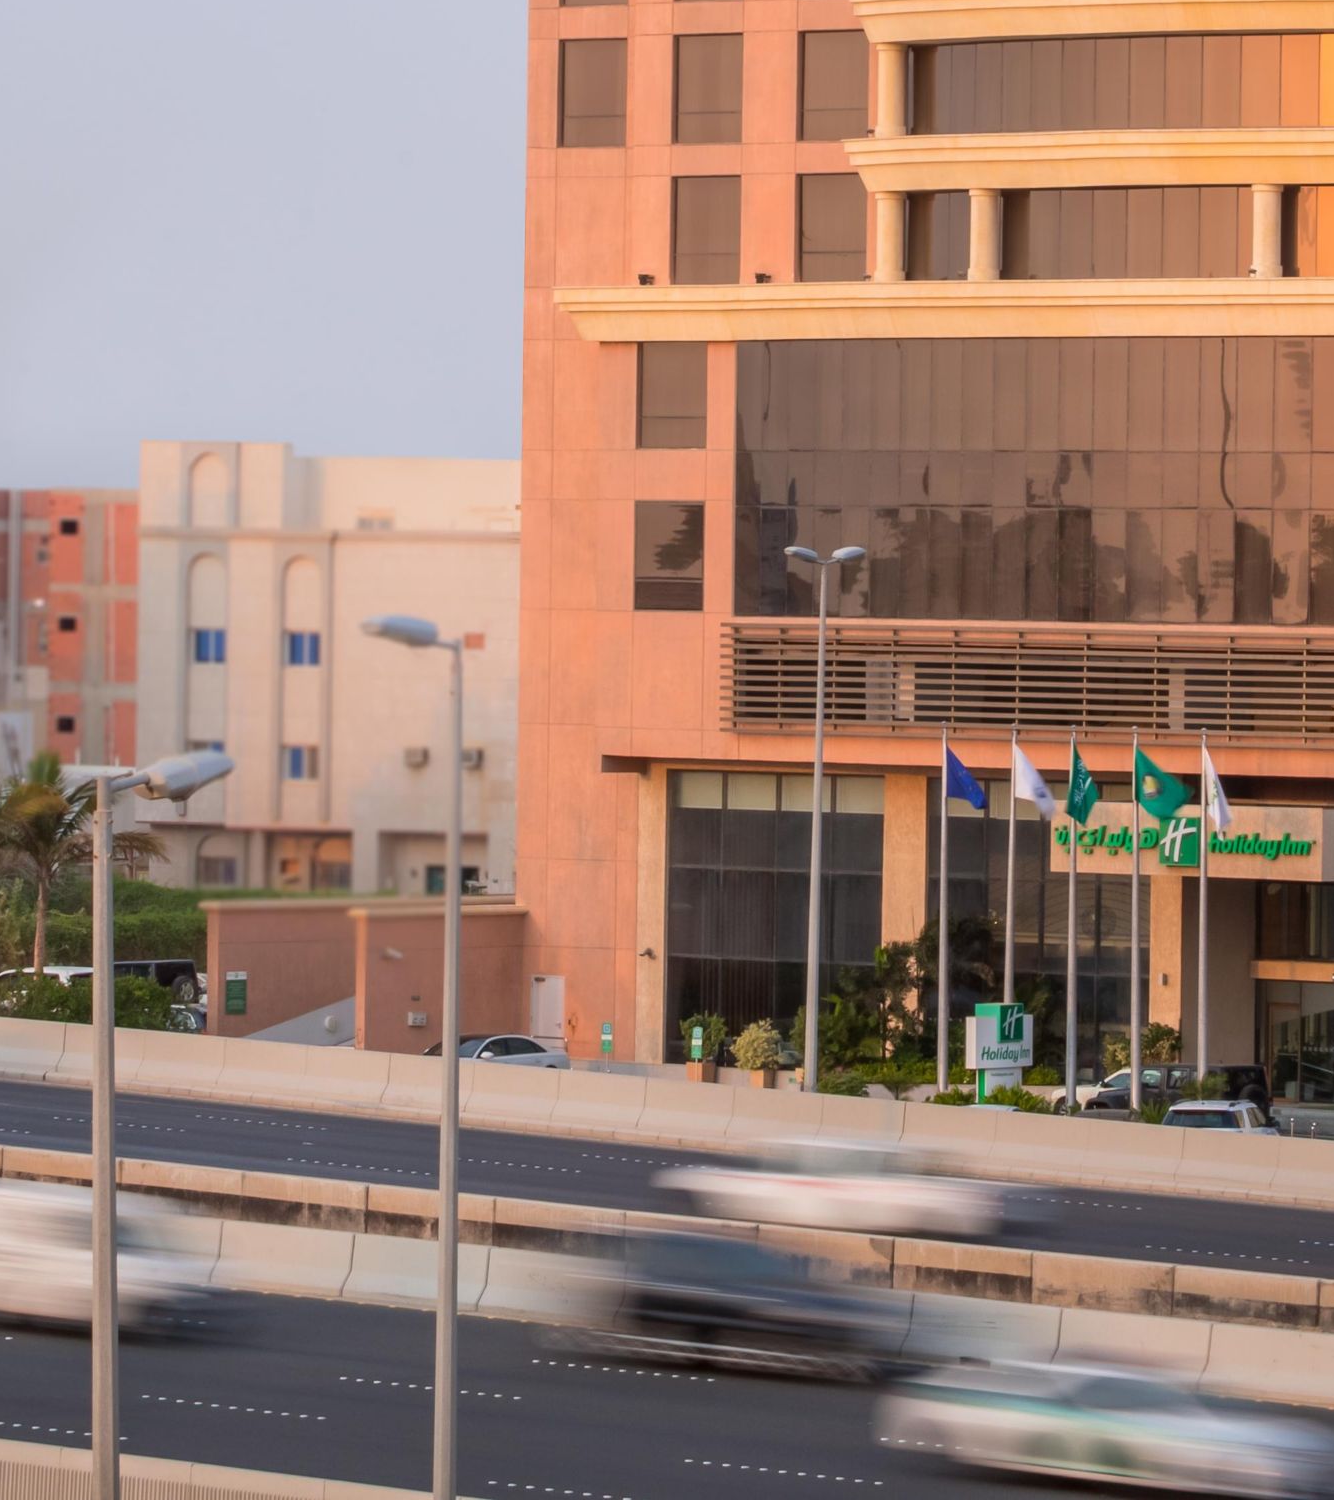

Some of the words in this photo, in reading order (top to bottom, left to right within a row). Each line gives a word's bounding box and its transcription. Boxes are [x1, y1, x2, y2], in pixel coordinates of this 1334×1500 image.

[1209, 831, 1279, 860] Holiday
[1279, 832, 1312, 856] Inn
[981, 1046, 1019, 1062] Holiday
[1020, 1045, 1030, 1059] Inn
